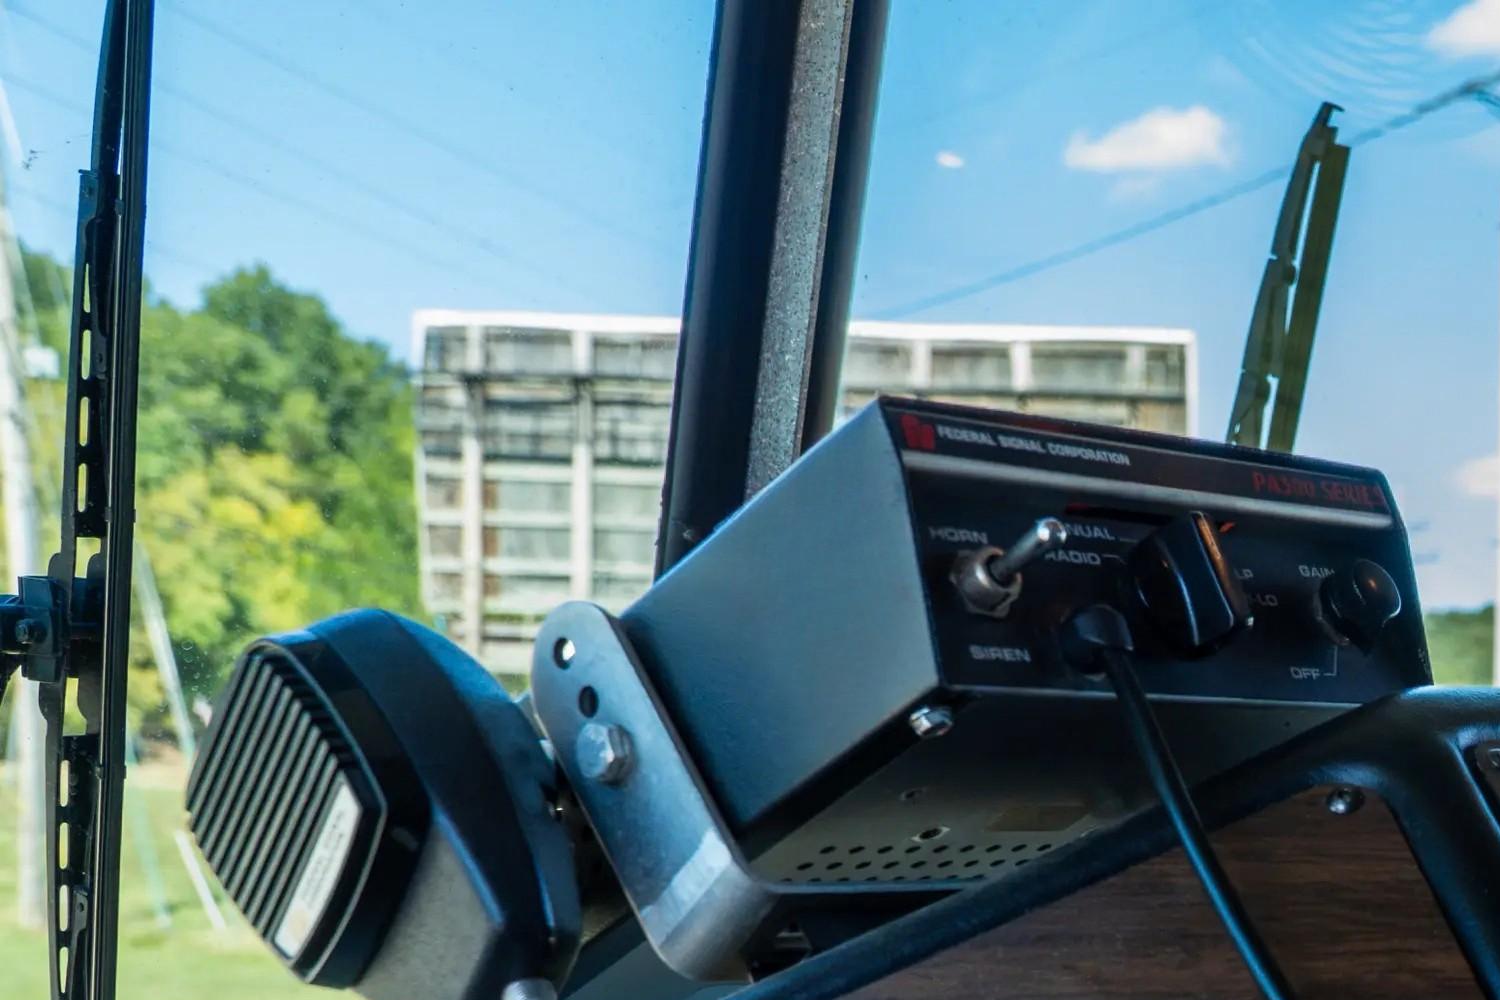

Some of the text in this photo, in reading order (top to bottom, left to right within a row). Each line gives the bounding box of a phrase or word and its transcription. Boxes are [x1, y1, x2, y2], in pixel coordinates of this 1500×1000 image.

[937, 425, 1130, 466] FEDERAL SIGNAL CORPORATION
[929, 526, 988, 544] HORN
[1064, 522, 1115, 540] NUAL
[969, 644, 1031, 662] SIREN
[1290, 666, 1320, 680] OFF
